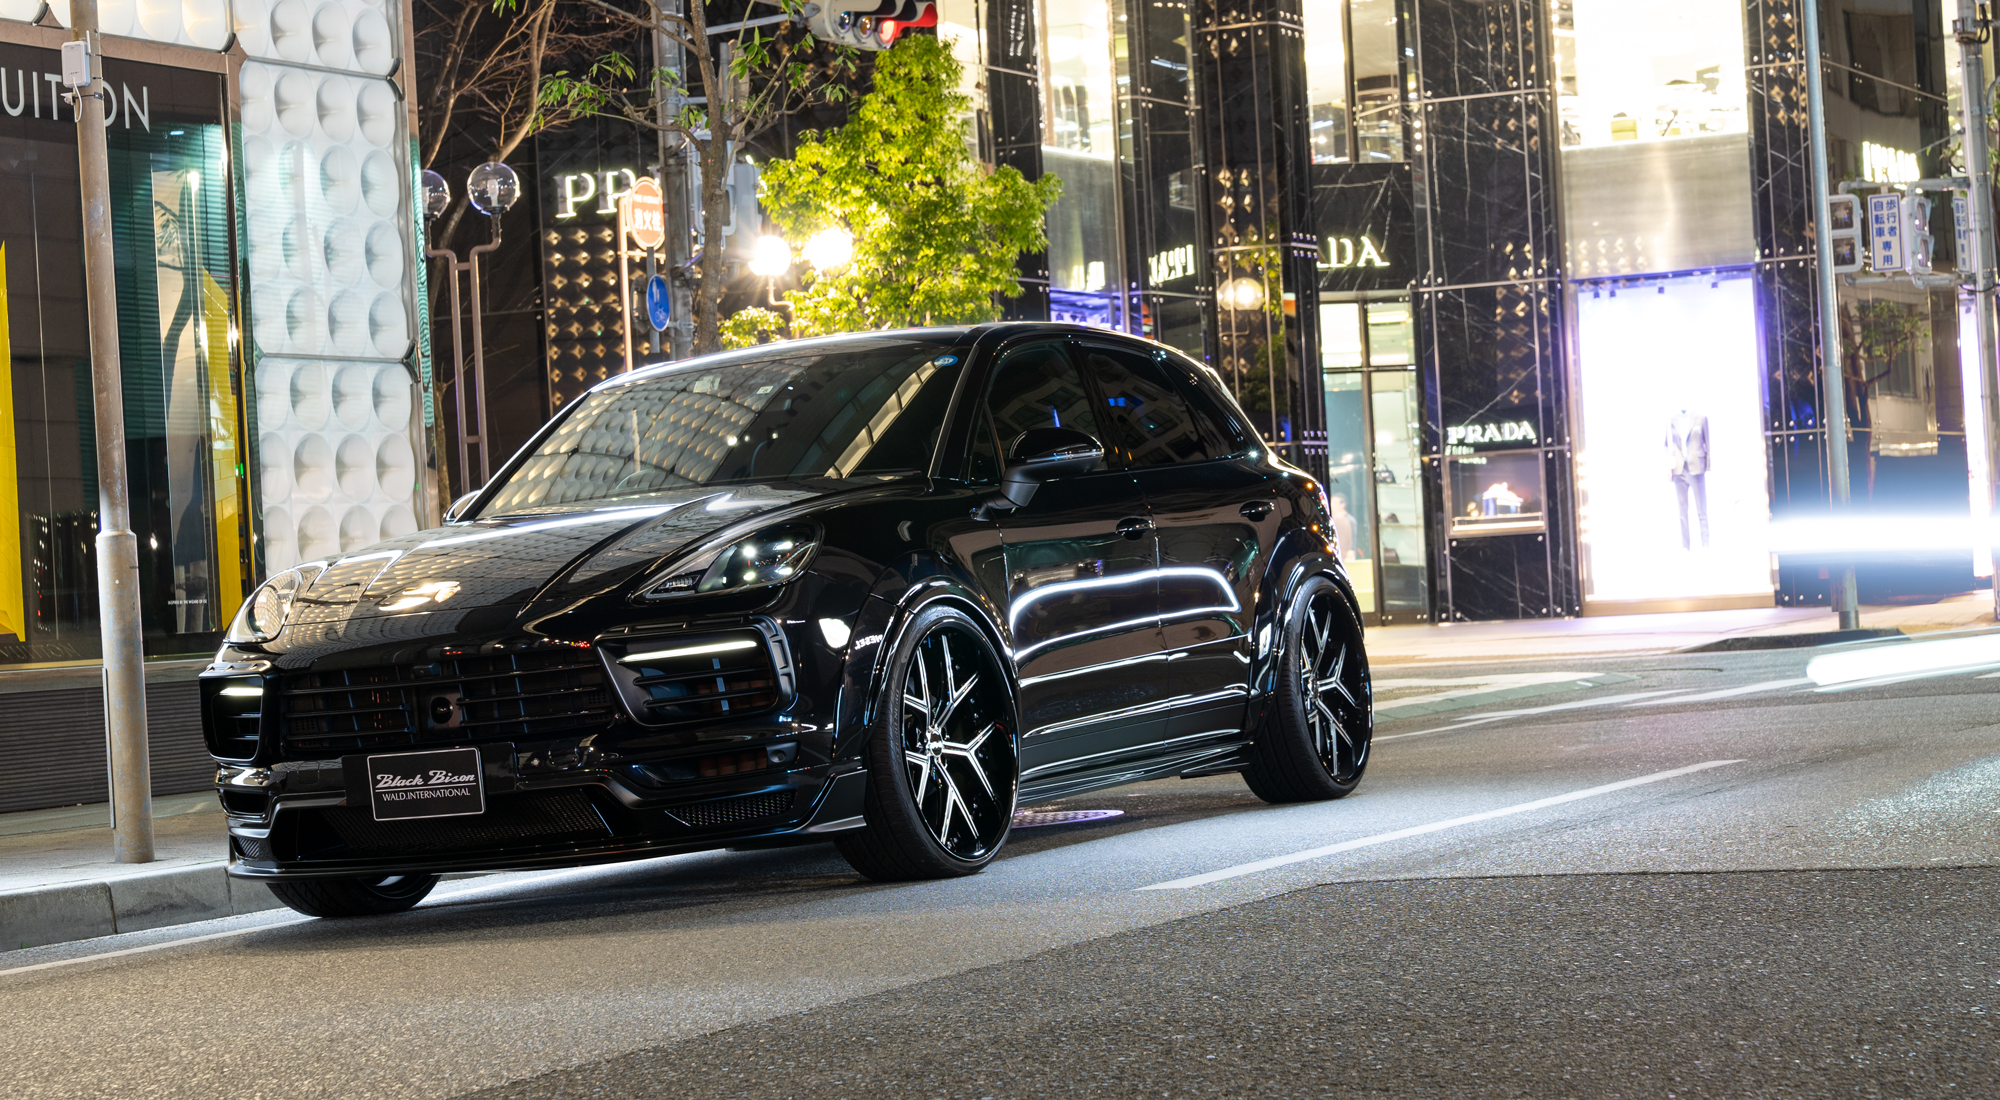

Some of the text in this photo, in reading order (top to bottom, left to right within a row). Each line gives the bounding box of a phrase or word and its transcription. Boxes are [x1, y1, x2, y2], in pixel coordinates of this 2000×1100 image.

[0, 67, 150, 133] UITON
[1873, 200, 1886, 238] 自転車
[1886, 199, 1898, 237] 歩行者
[1882, 240, 1894, 267] 専用
[1446, 420, 1537, 445] PRADA
[375, 769, 476, 788] Black Bison
[382, 788, 471, 801] WALD.INTERNATIONAL
